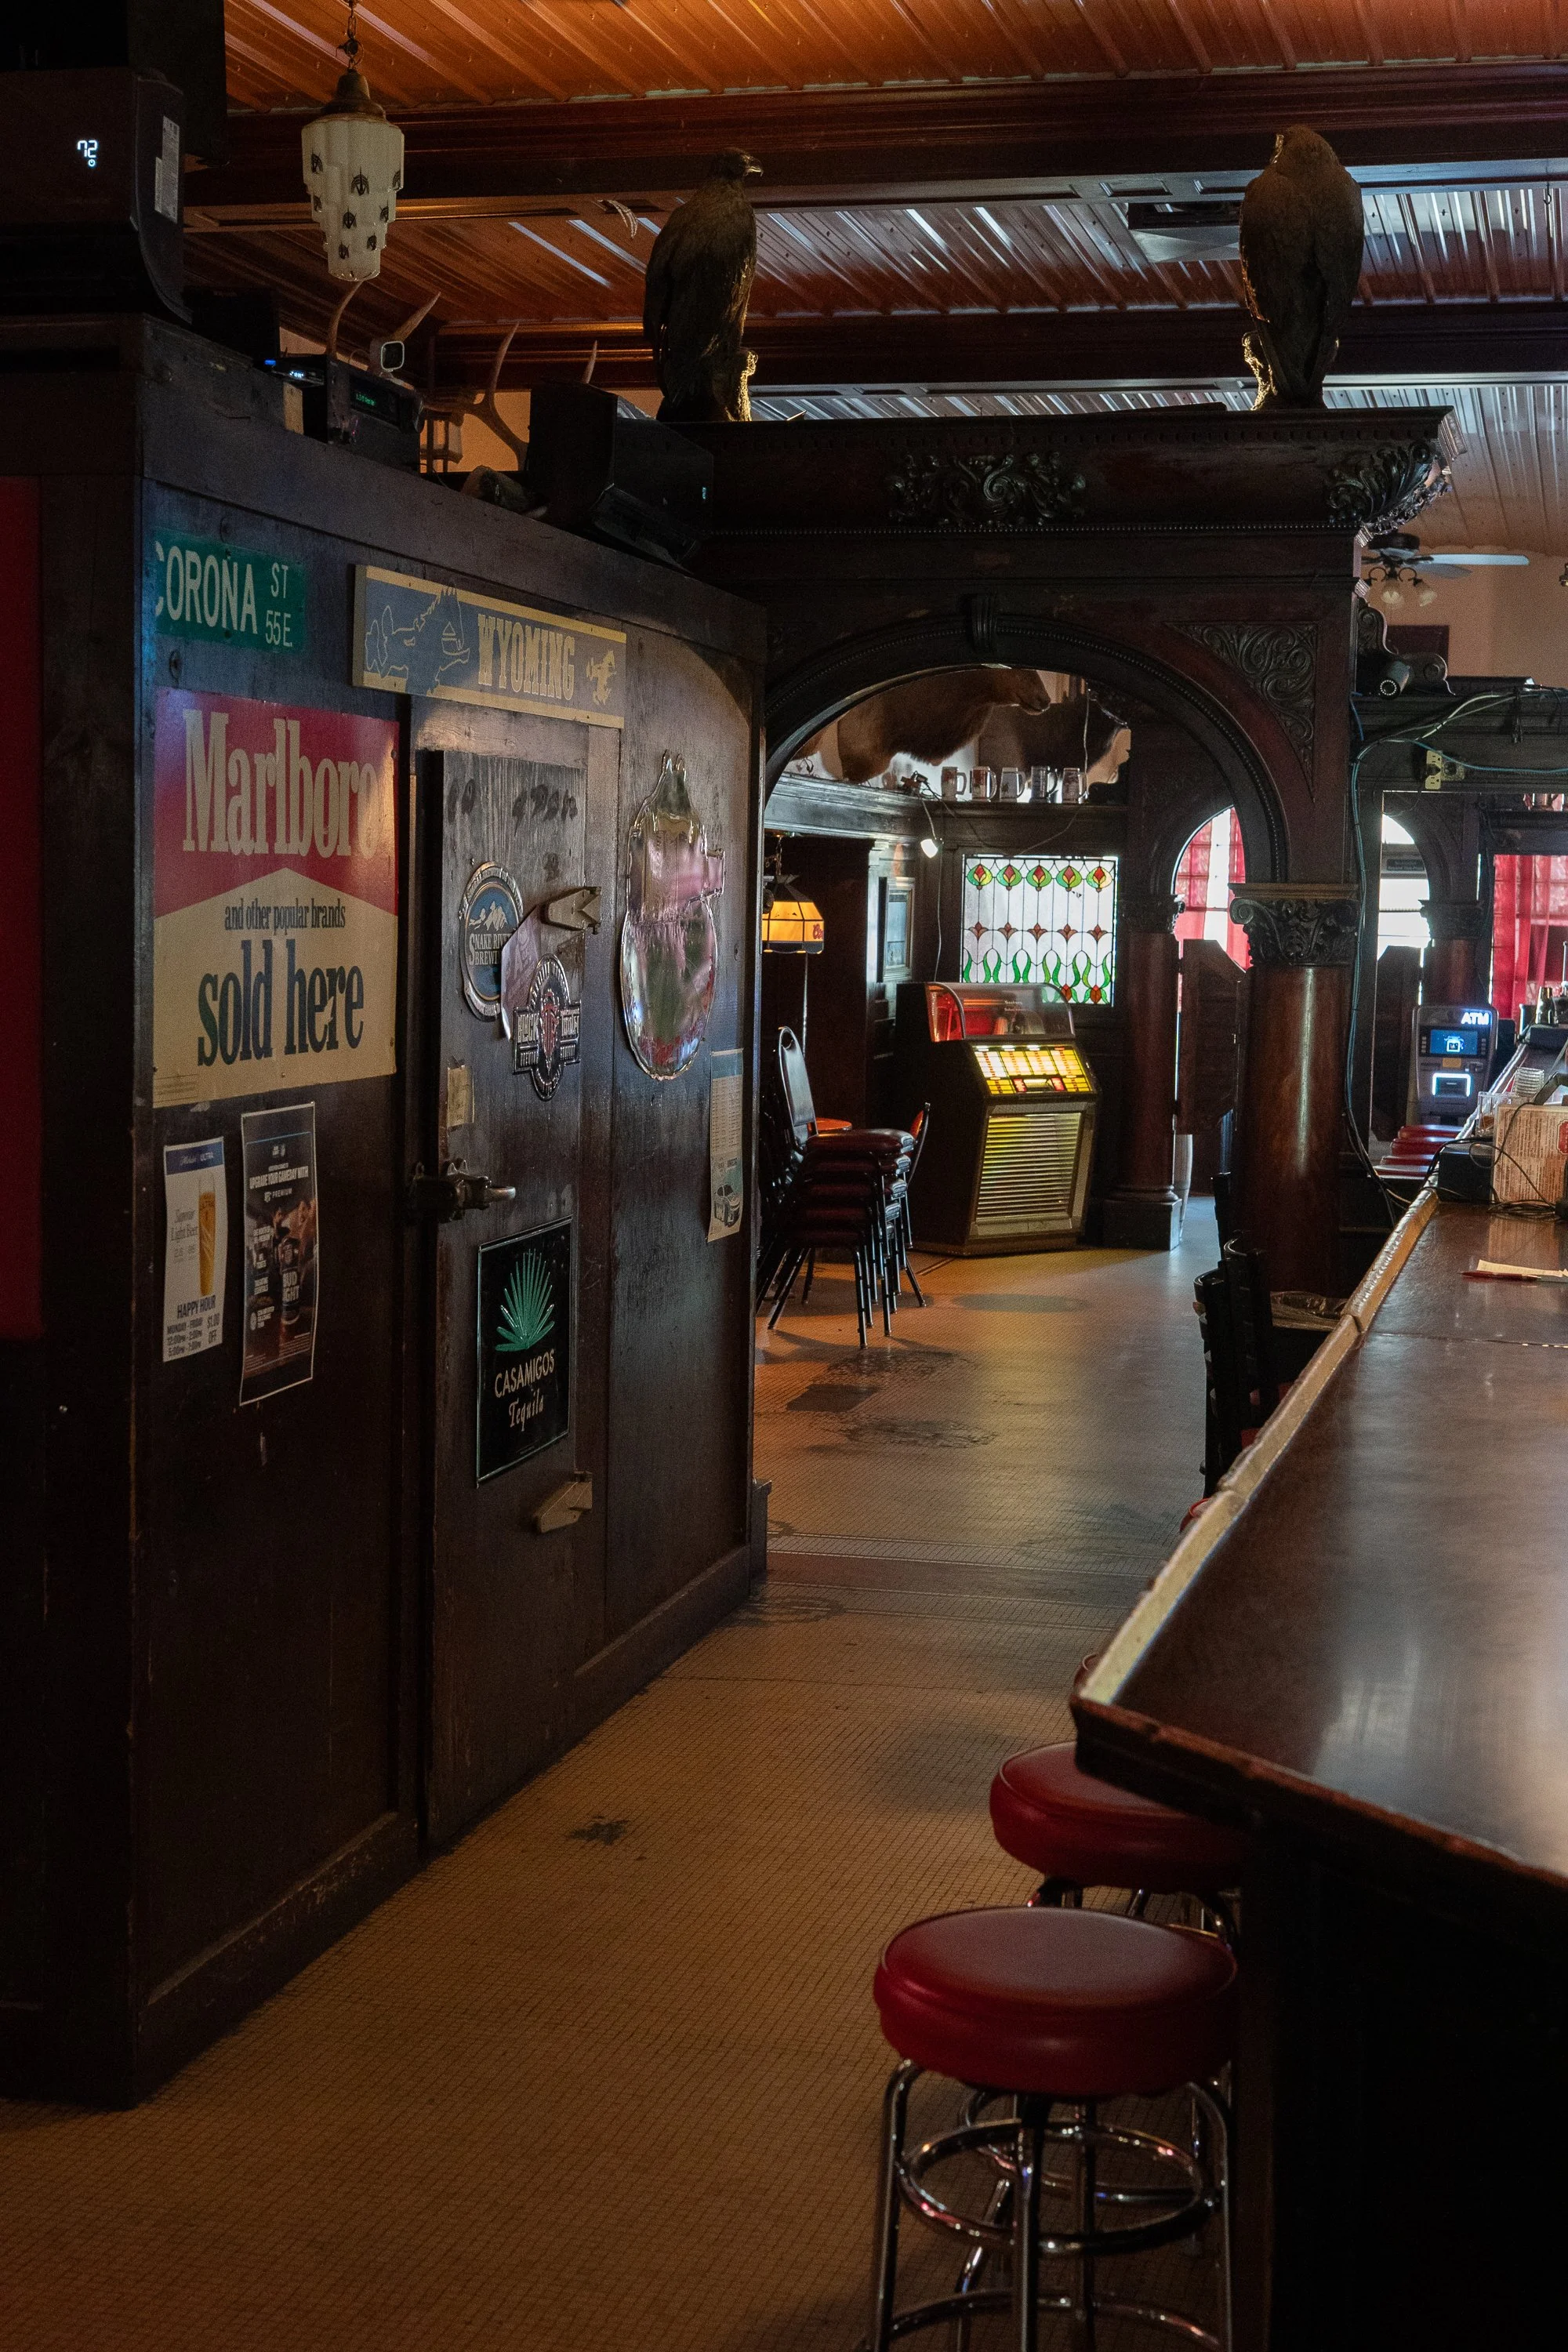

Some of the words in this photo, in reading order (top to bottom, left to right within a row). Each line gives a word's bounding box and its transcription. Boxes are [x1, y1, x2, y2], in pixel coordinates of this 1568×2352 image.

[77, 140, 98, 158] 72
[270, 562, 289, 599] ST
[477, 614, 575, 700] WYOMING
[183, 709, 380, 858] Marlboro
[225, 898, 244, 931] and
[245, 898, 271, 931] other
[274, 898, 310, 936] popular
[311, 898, 346, 929] brands
[198, 939, 273, 1067] sold
[285, 938, 365, 1055] here
[1461, 1012, 1490, 1025] ATM
[177, 1301, 198, 1319] HAPPY
[199, 1294, 216, 1313] HOUR
[494, 1348, 555, 1399] CASAMIGOS
[508, 1387, 544, 1432] Tequila
